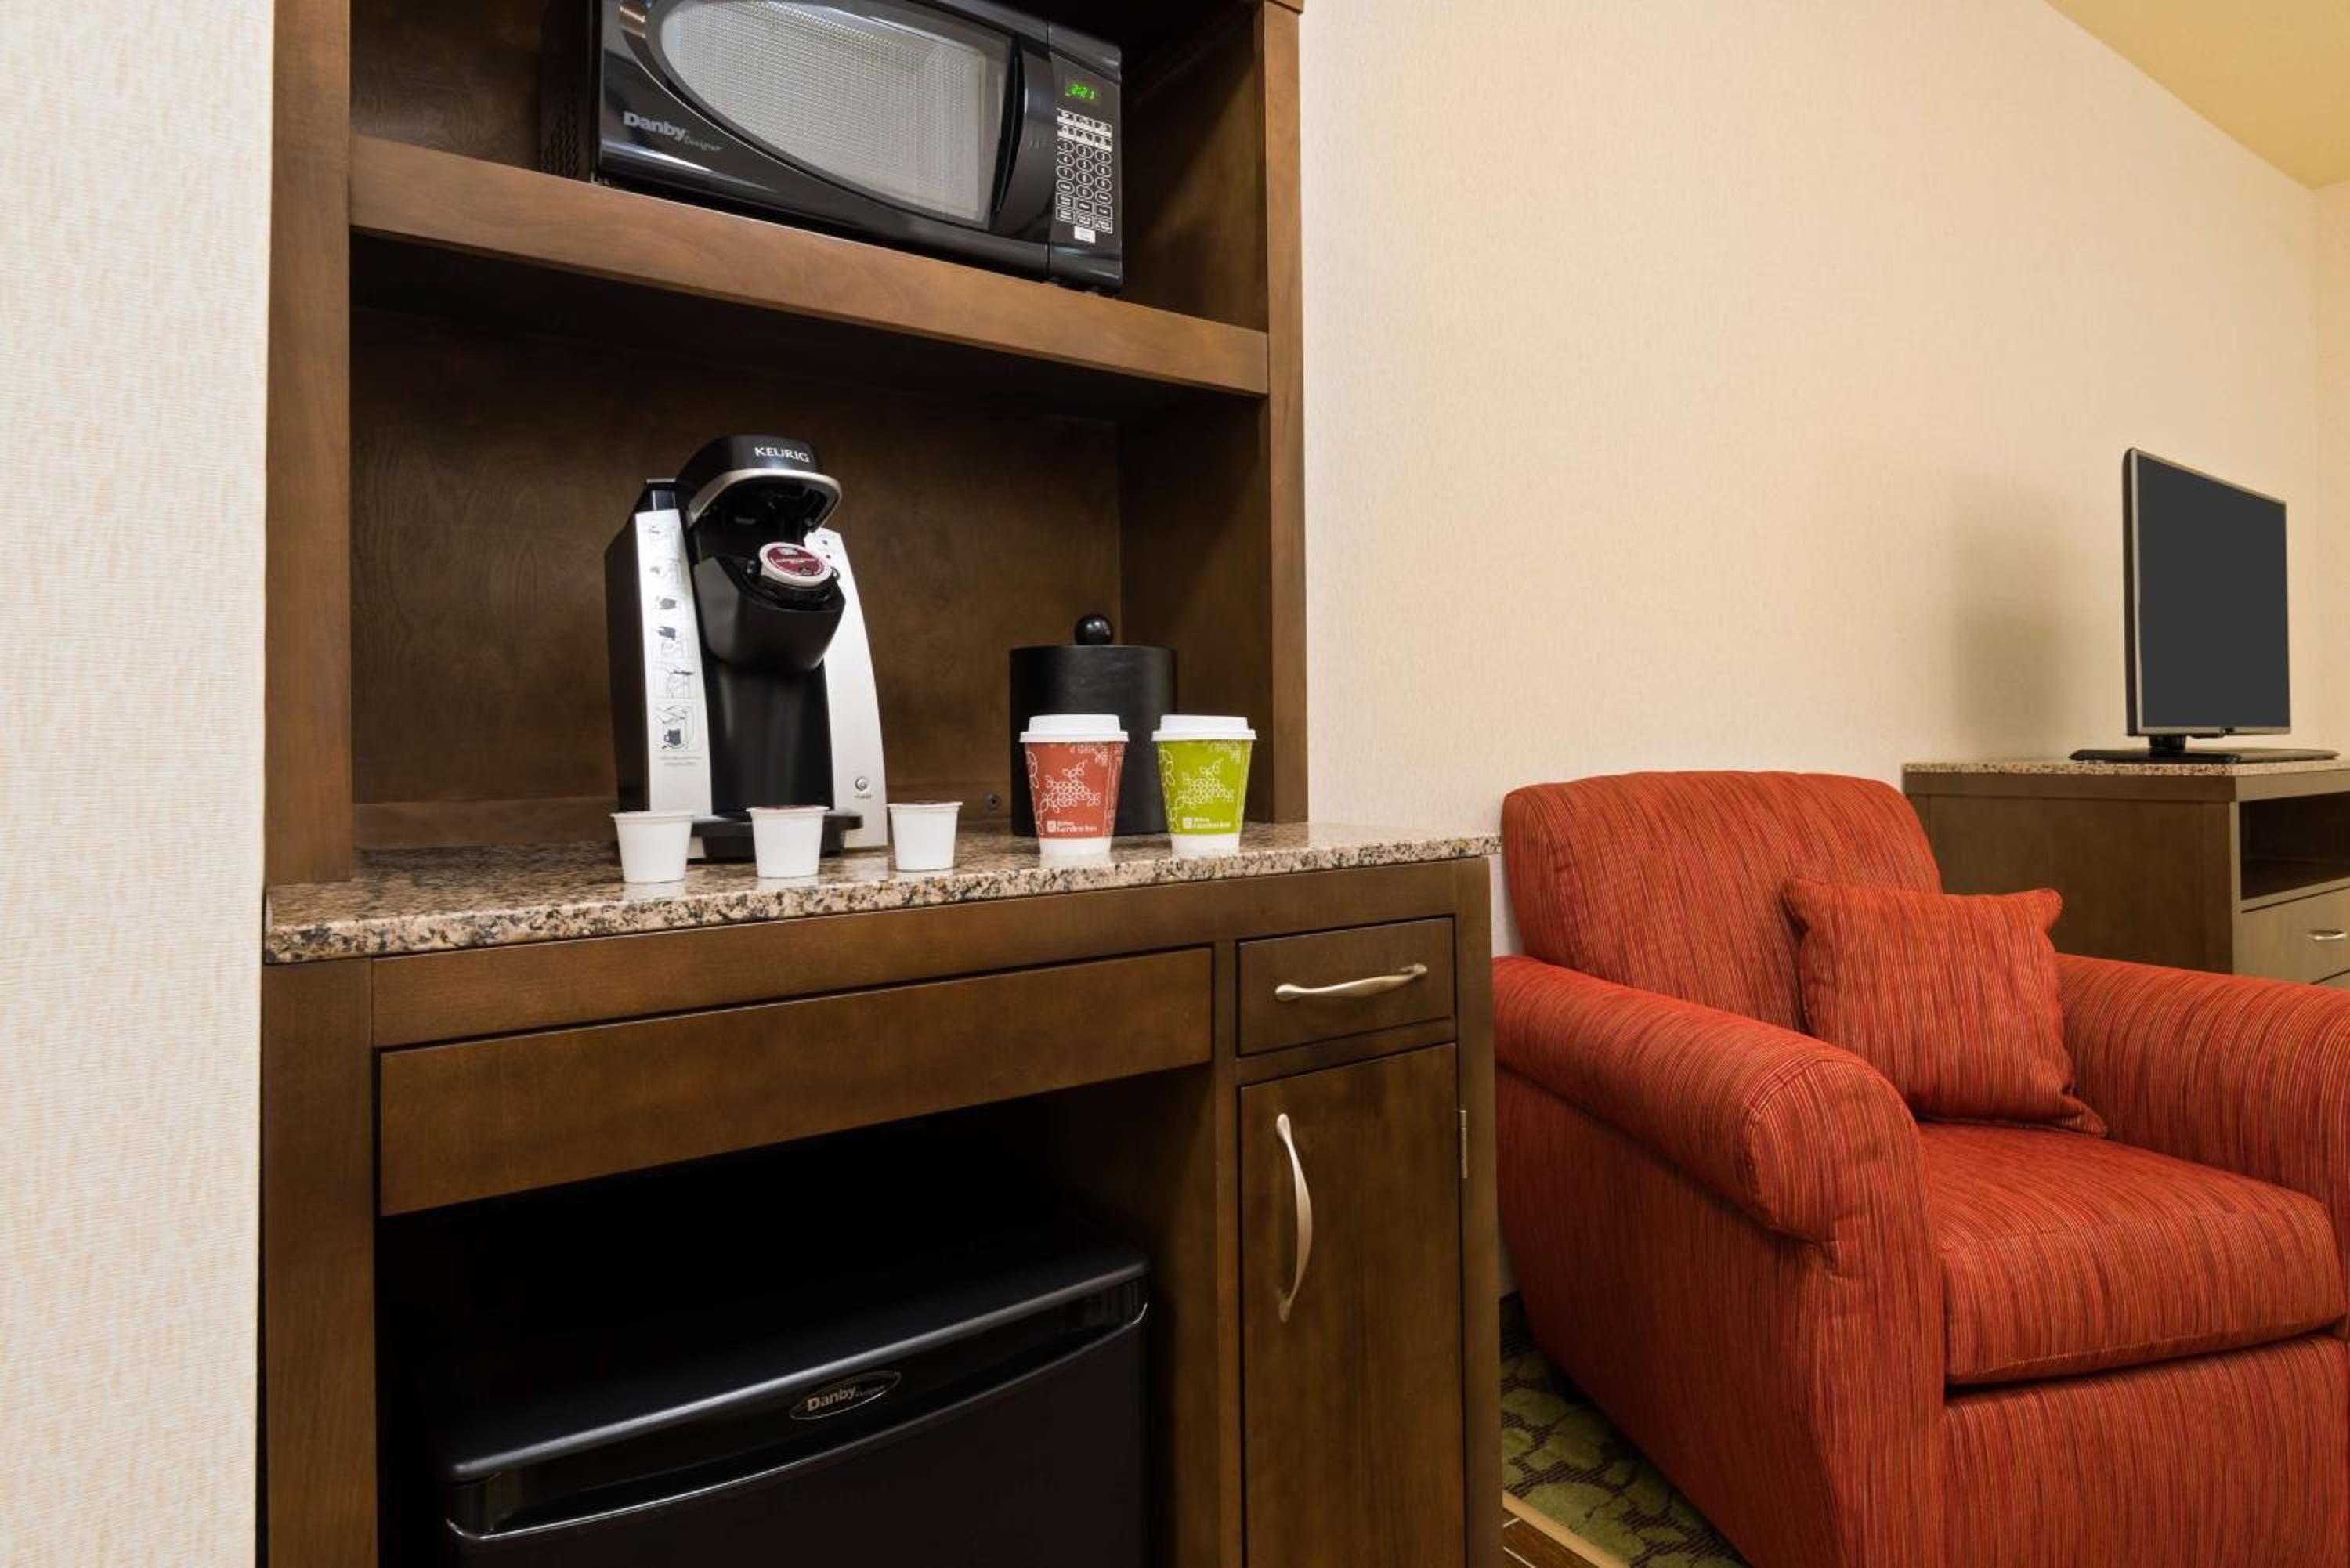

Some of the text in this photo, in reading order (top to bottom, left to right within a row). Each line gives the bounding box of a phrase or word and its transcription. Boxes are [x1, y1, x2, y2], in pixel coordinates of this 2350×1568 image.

[623, 111, 686, 140] Danby
[754, 446, 811, 463] KEURIG
[808, 1386, 856, 1411] Danby
